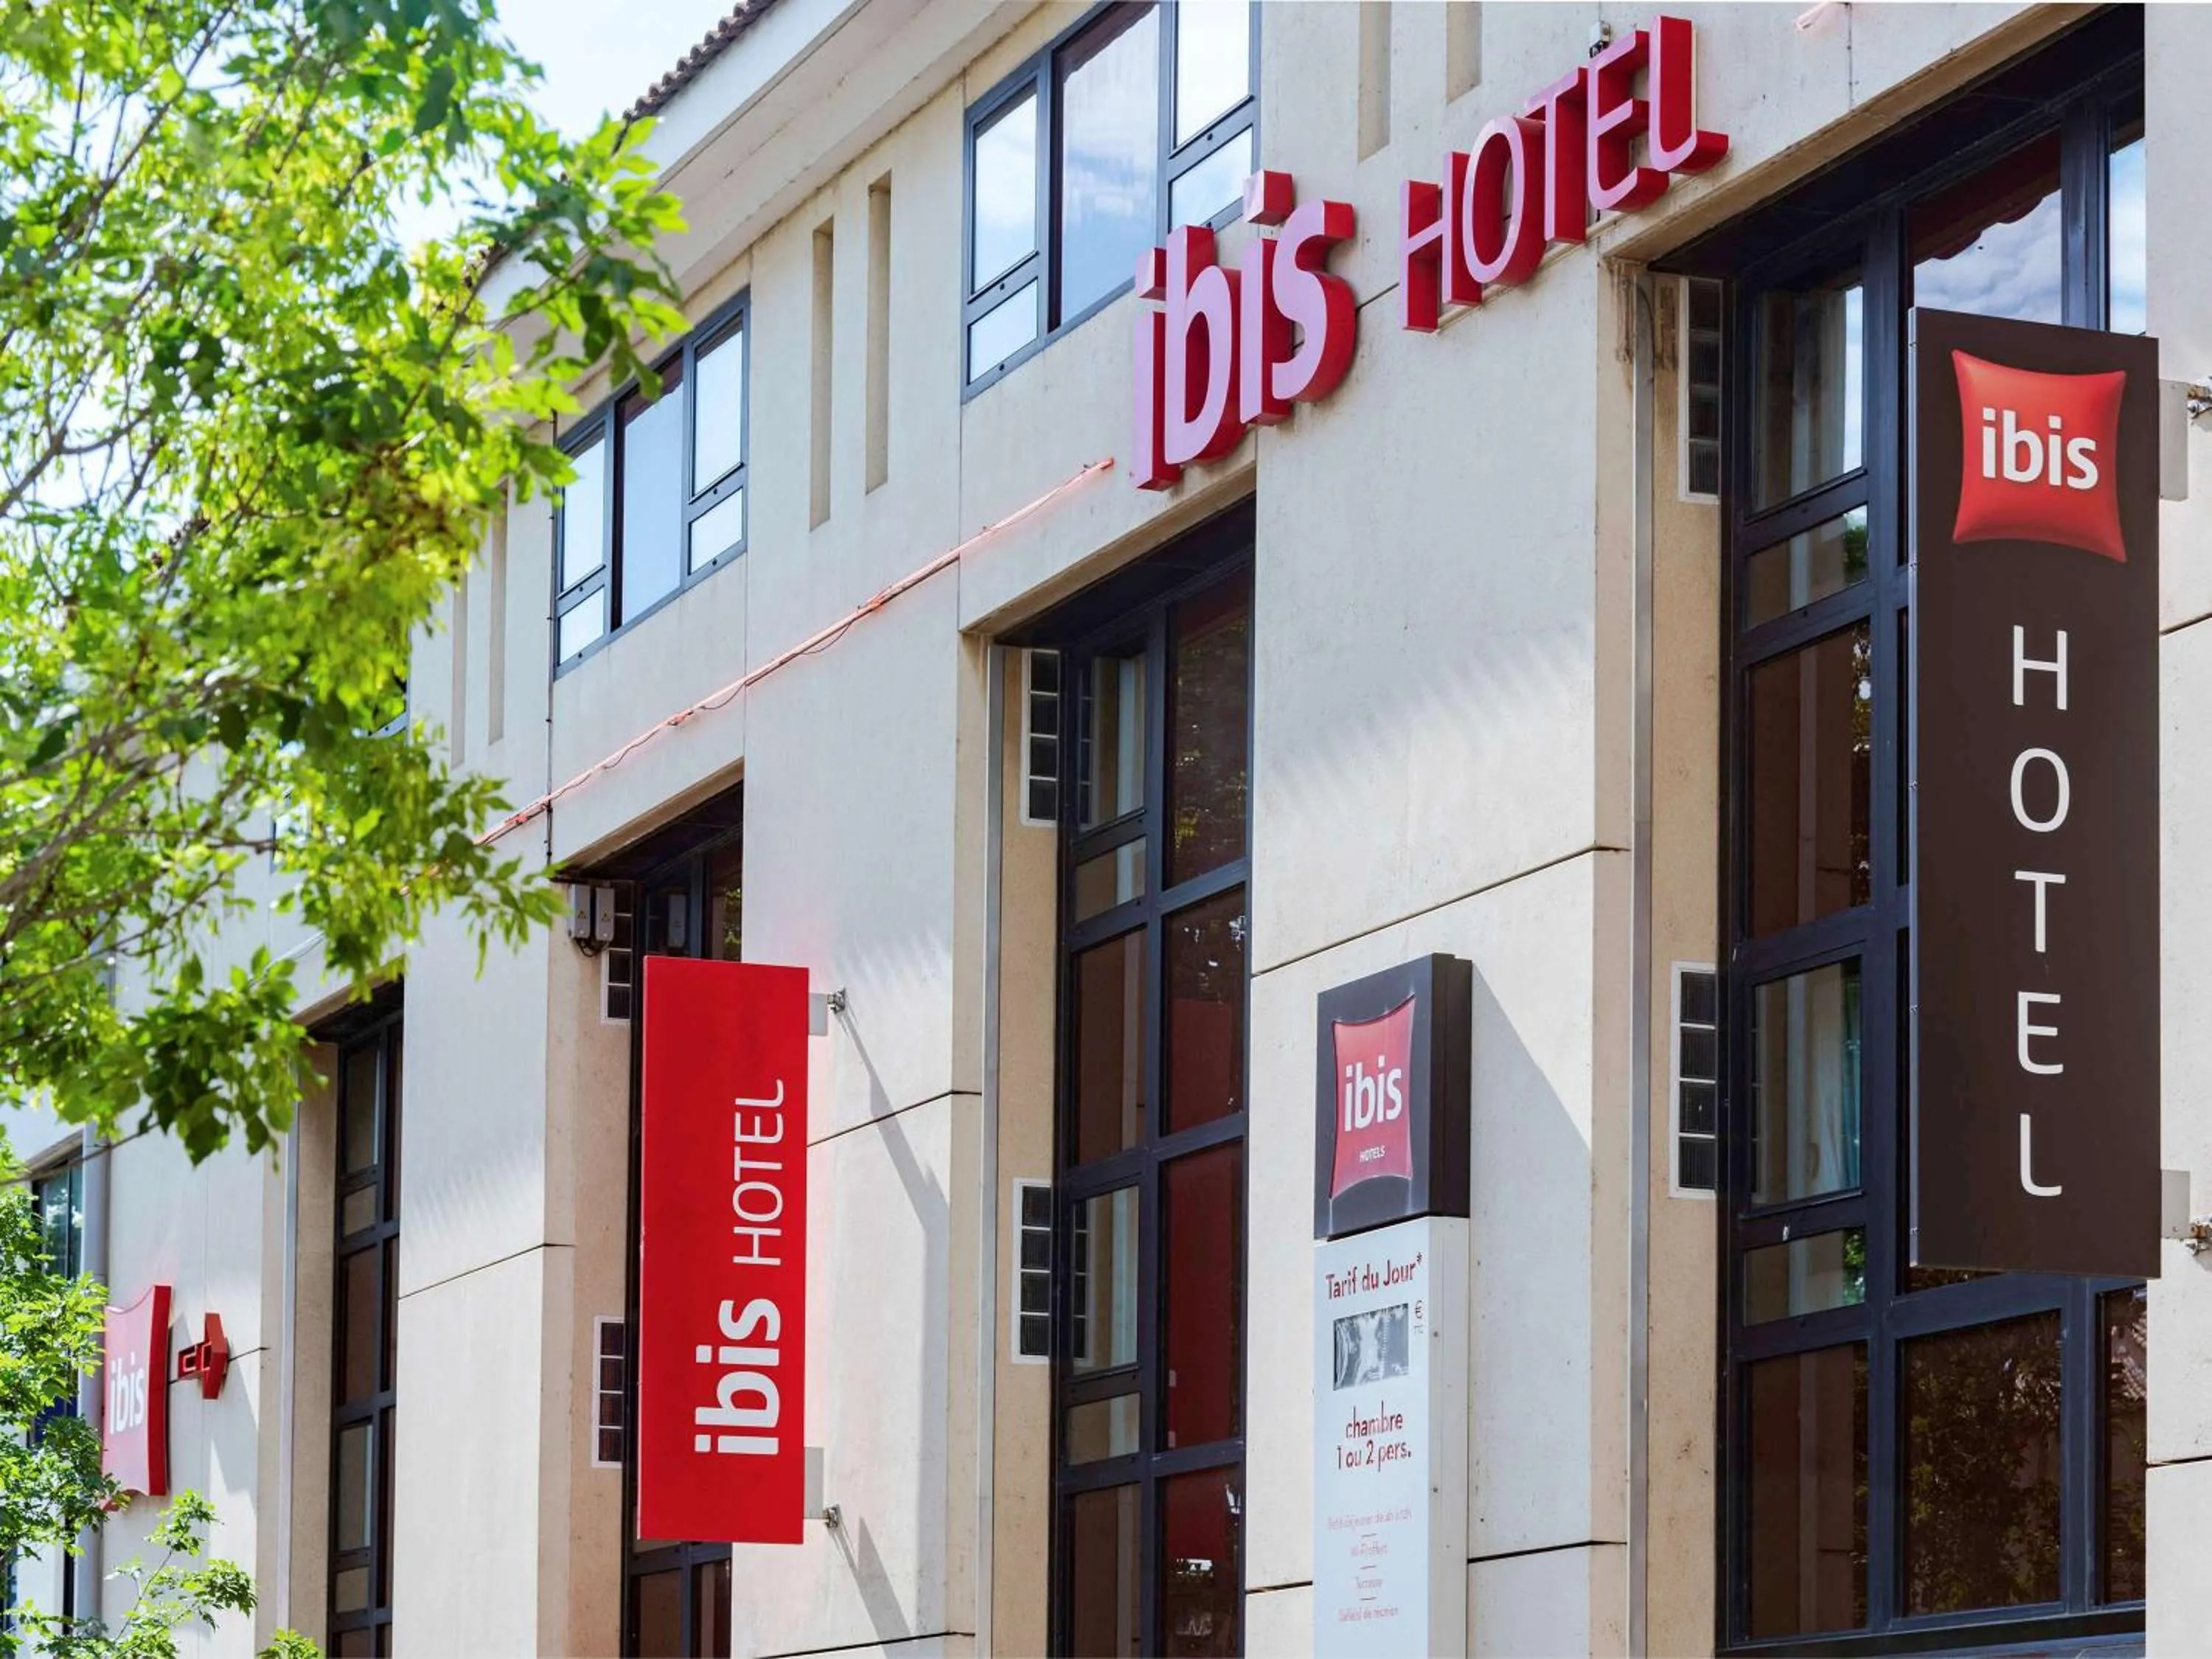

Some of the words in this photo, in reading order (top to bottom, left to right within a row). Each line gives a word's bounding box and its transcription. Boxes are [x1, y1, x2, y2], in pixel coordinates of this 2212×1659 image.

[1133, 170, 1356, 492] ibis
[1399, 15, 1728, 333] HOTEL
[1982, 406, 2099, 490] ibis
[2010, 624, 2070, 1197] HOTEL
[1344, 1054, 1402, 1133] ibis
[732, 1079, 785, 1266] HOTEL
[1359, 1145, 1386, 1163] HOTELS
[1325, 1266, 1358, 1299] Tarif
[1362, 1263, 1380, 1290] du
[110, 1352, 145, 1436] ibis
[694, 1298, 782, 1455] ibis
[1345, 1446, 1363, 1468] ou
[1366, 1439, 1374, 1465] 2
[1377, 1441, 1413, 1472] pers.
[1346, 1399, 1403, 1439] chambre
